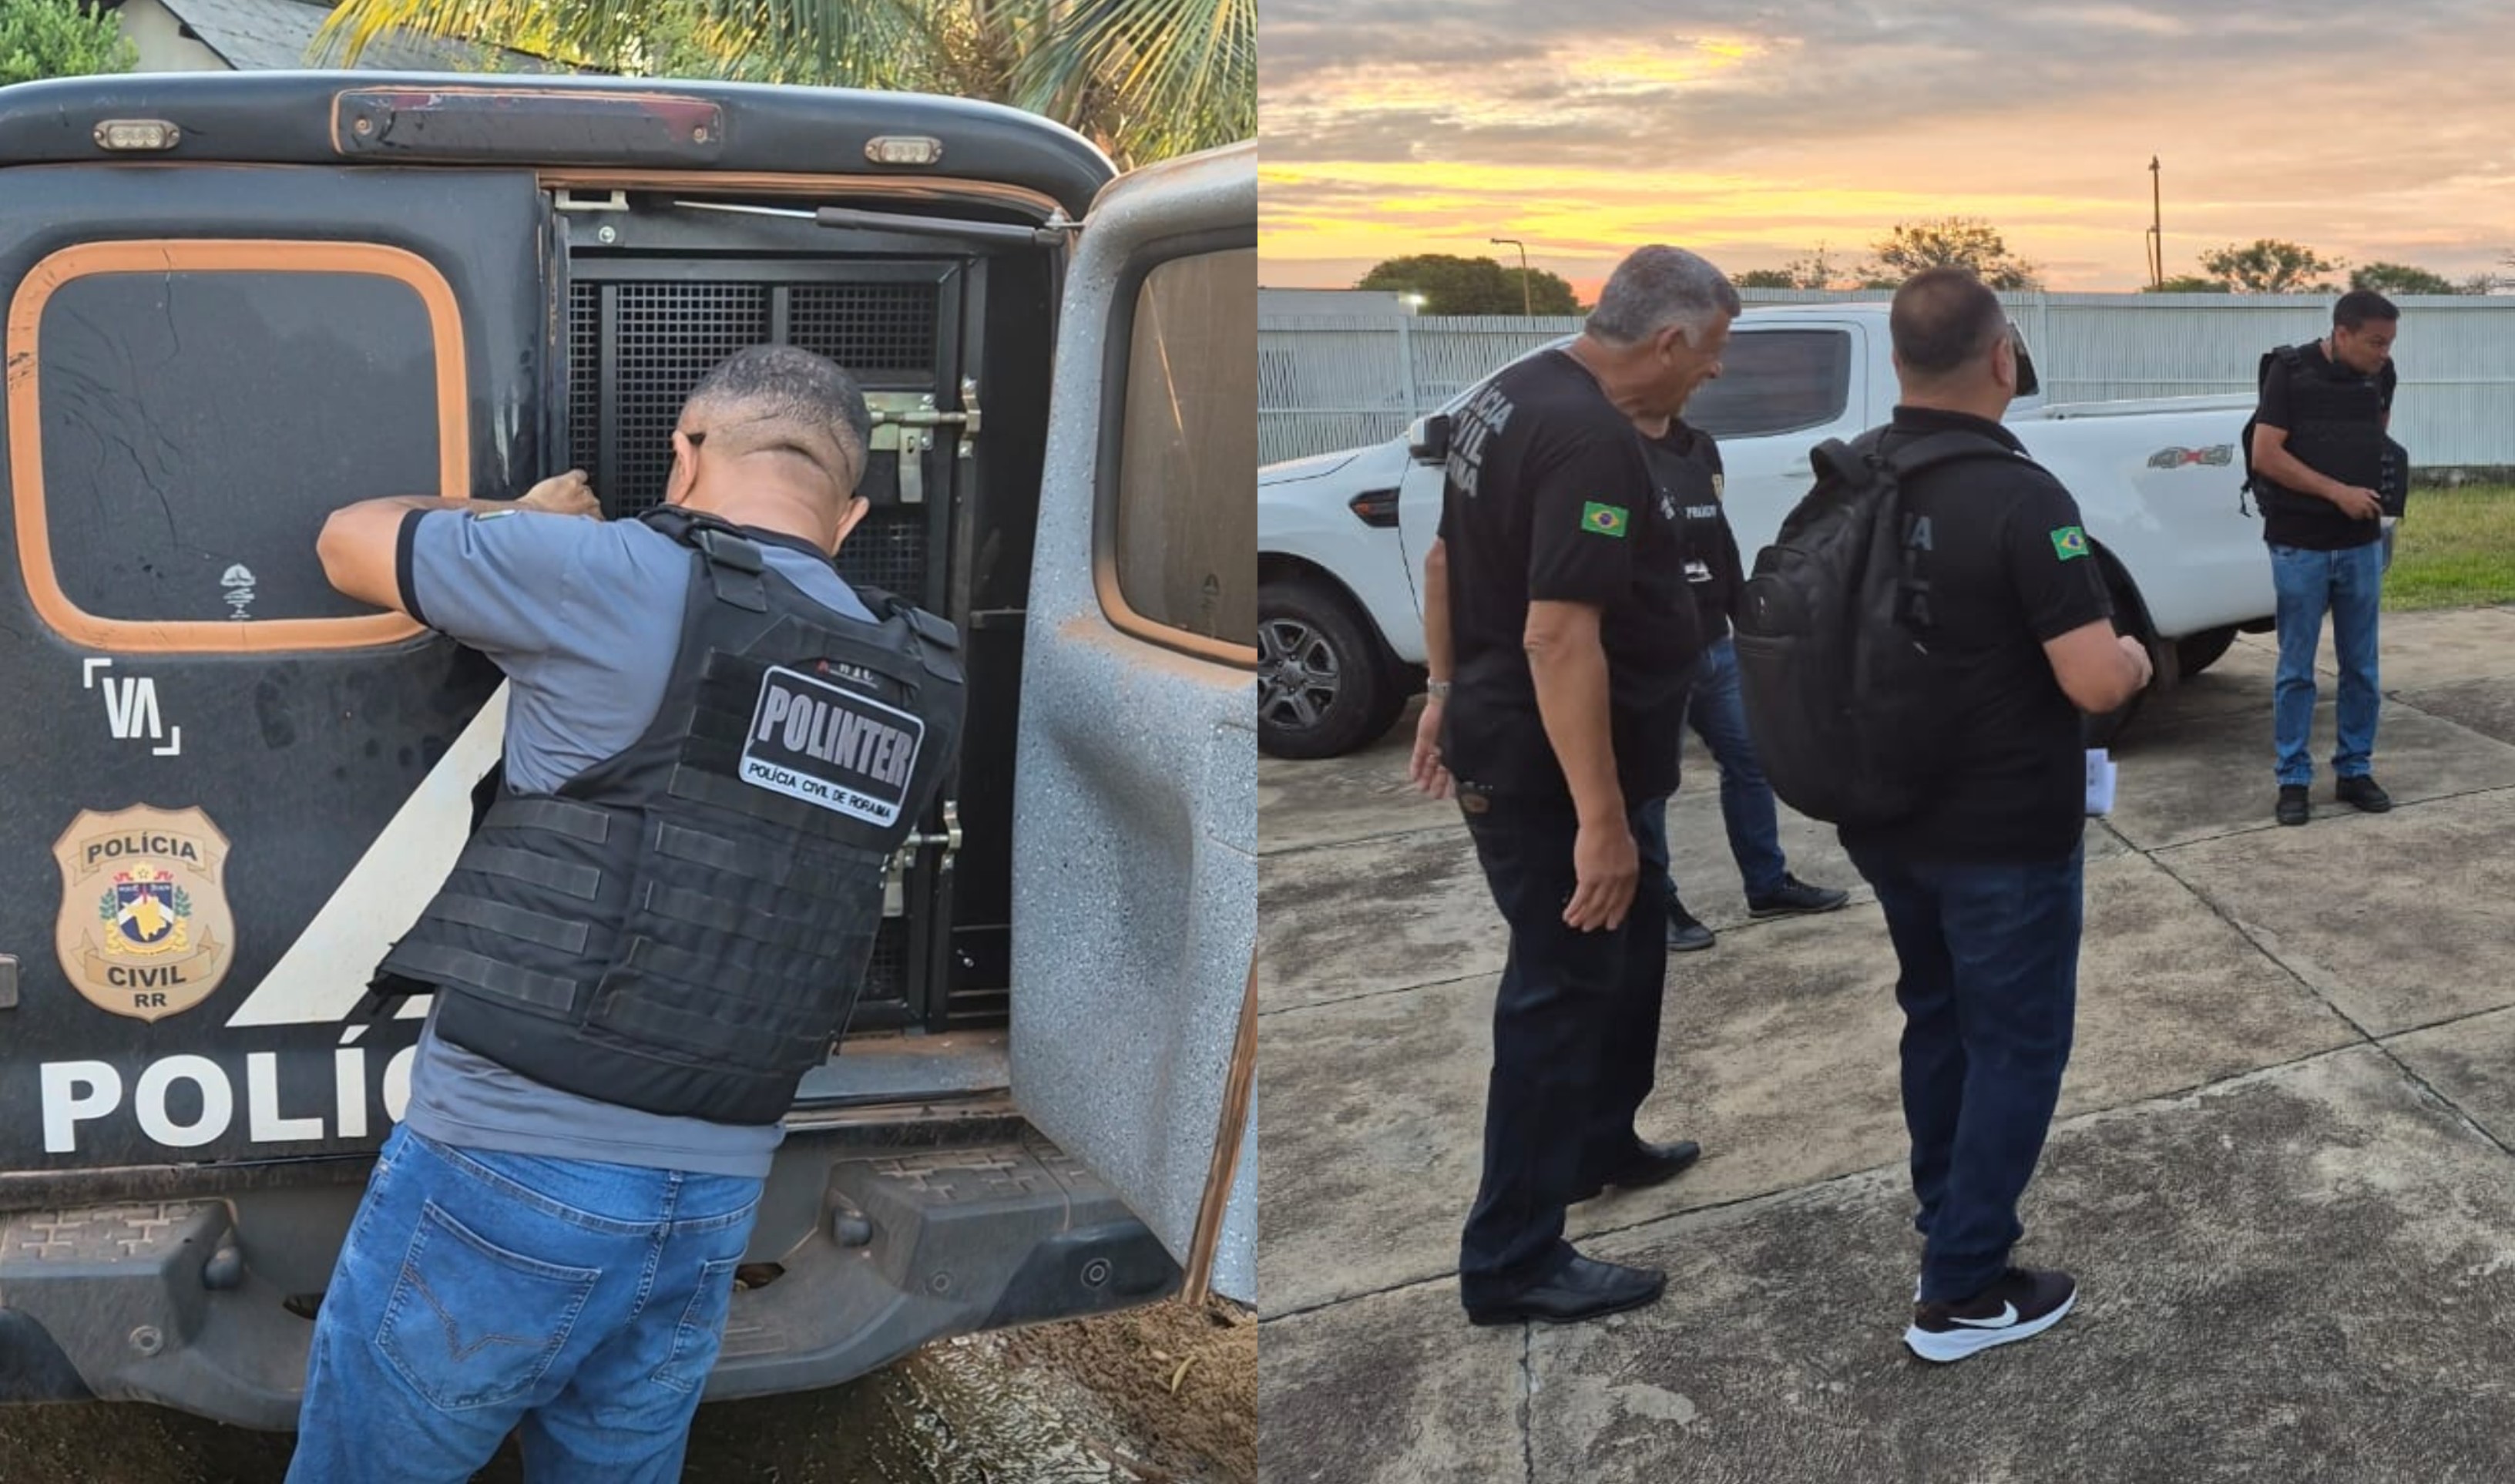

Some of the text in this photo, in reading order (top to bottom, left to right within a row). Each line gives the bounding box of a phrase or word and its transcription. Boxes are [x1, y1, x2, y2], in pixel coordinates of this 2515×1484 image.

[102, 677, 163, 739] VA
[757, 684, 913, 788] POLINTER
[748, 762, 797, 788] POLÍCIA
[802, 779, 829, 799] CIVIL
[832, 789, 847, 804] DE
[87, 831, 197, 864] POLÍCIA
[107, 965, 186, 988] CIVIL
[134, 992, 166, 1008] RR
